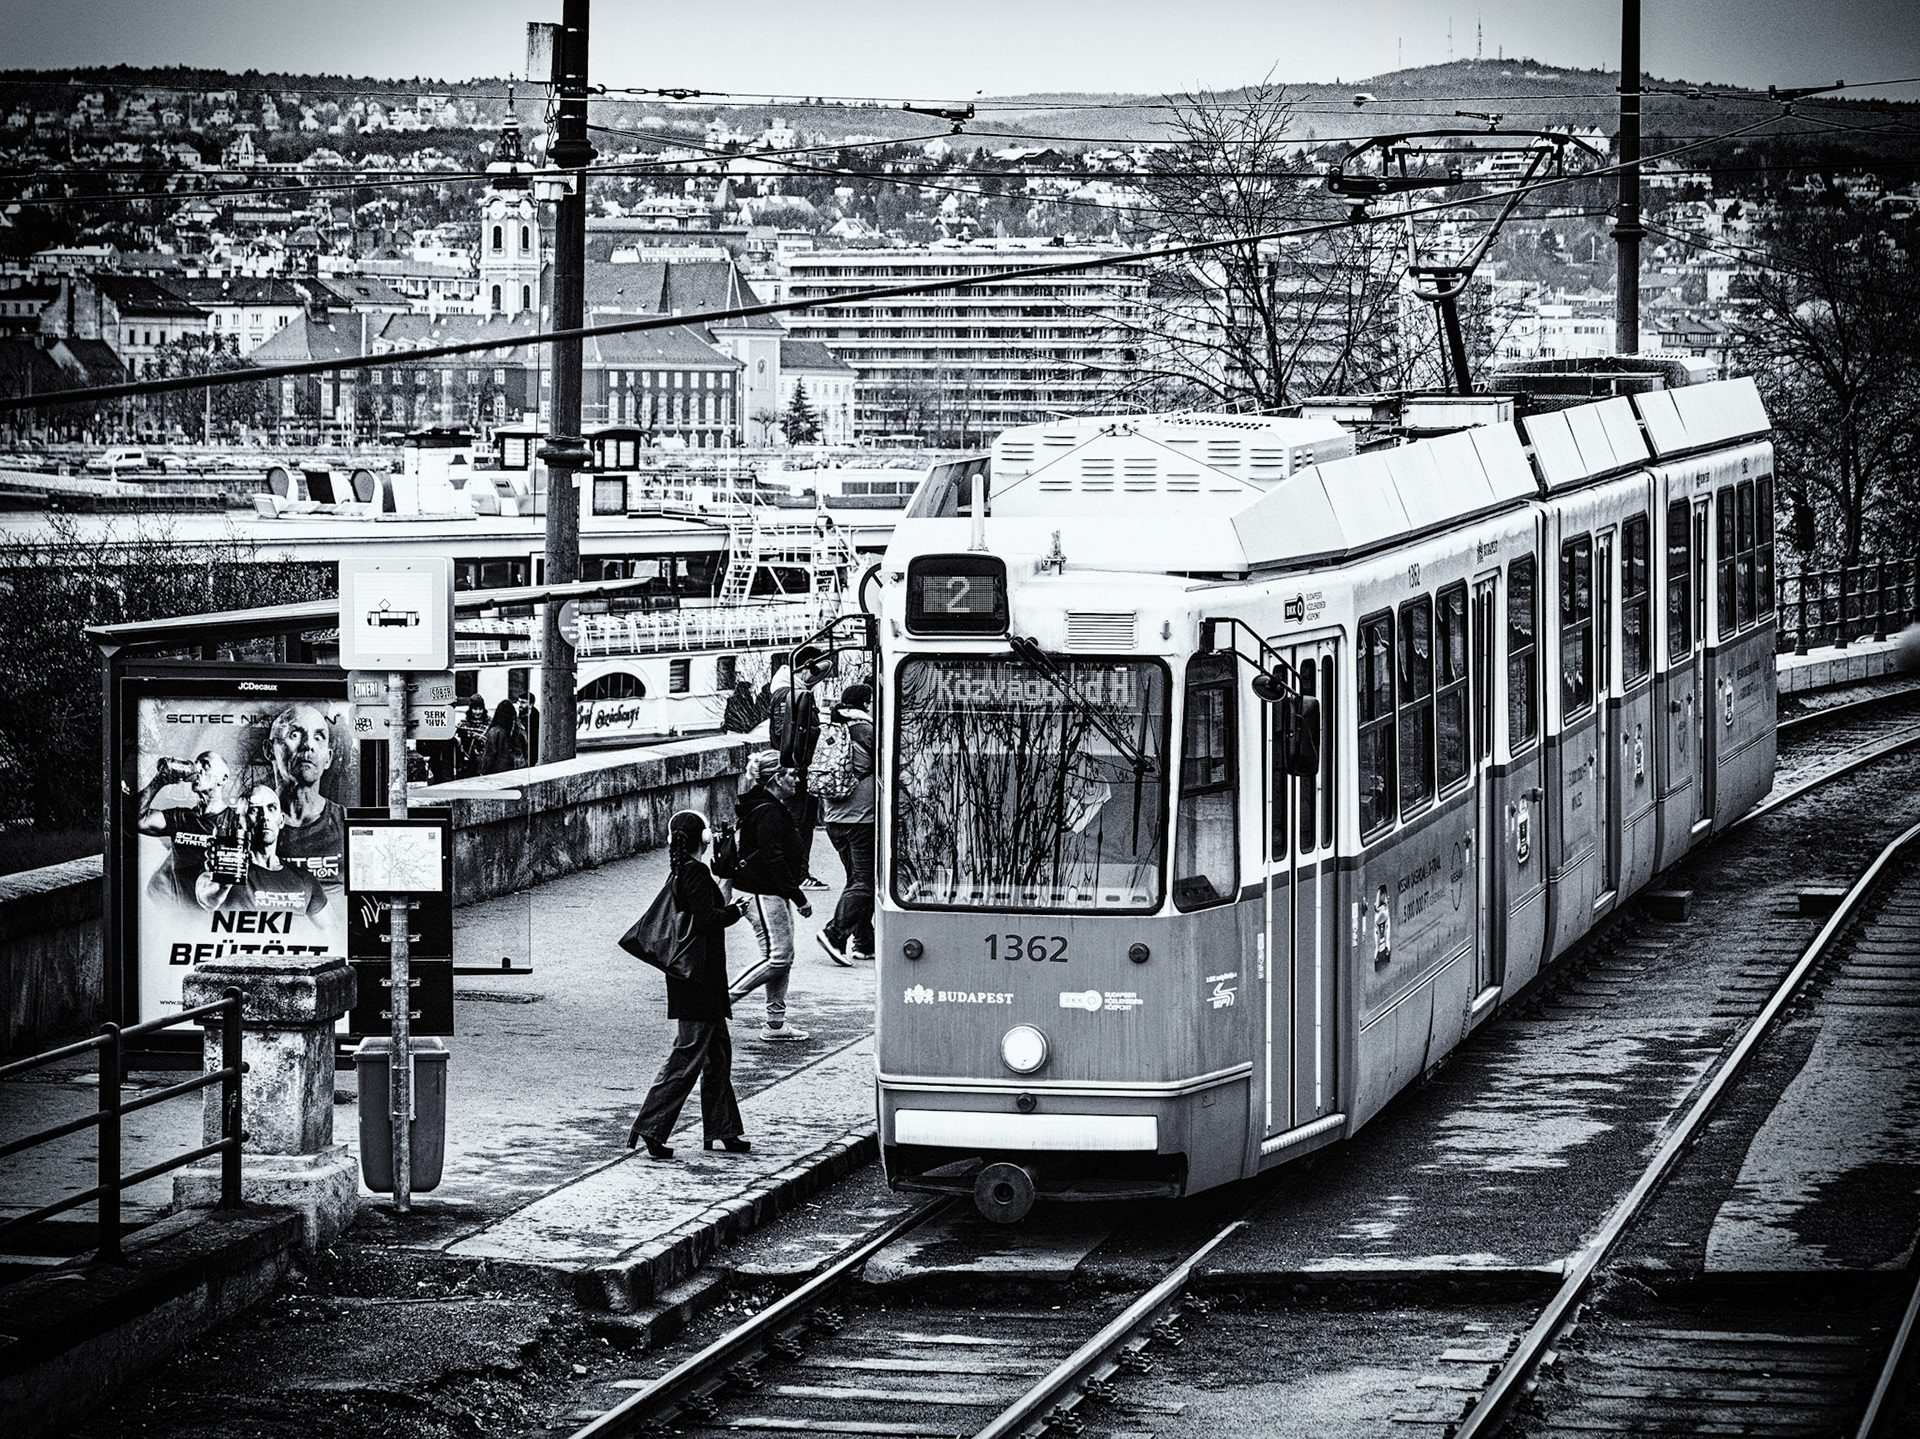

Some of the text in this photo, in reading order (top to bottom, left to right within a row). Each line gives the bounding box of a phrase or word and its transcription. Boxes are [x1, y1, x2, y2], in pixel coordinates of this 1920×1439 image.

[948, 577, 970, 613] 2
[238, 682, 278, 691] JCDecaux
[166, 714, 234, 724] SCITEC
[211, 911, 293, 934] NEKI
[984, 934, 1069, 963] 1362
[938, 991, 1014, 1005] BUDAPEST
